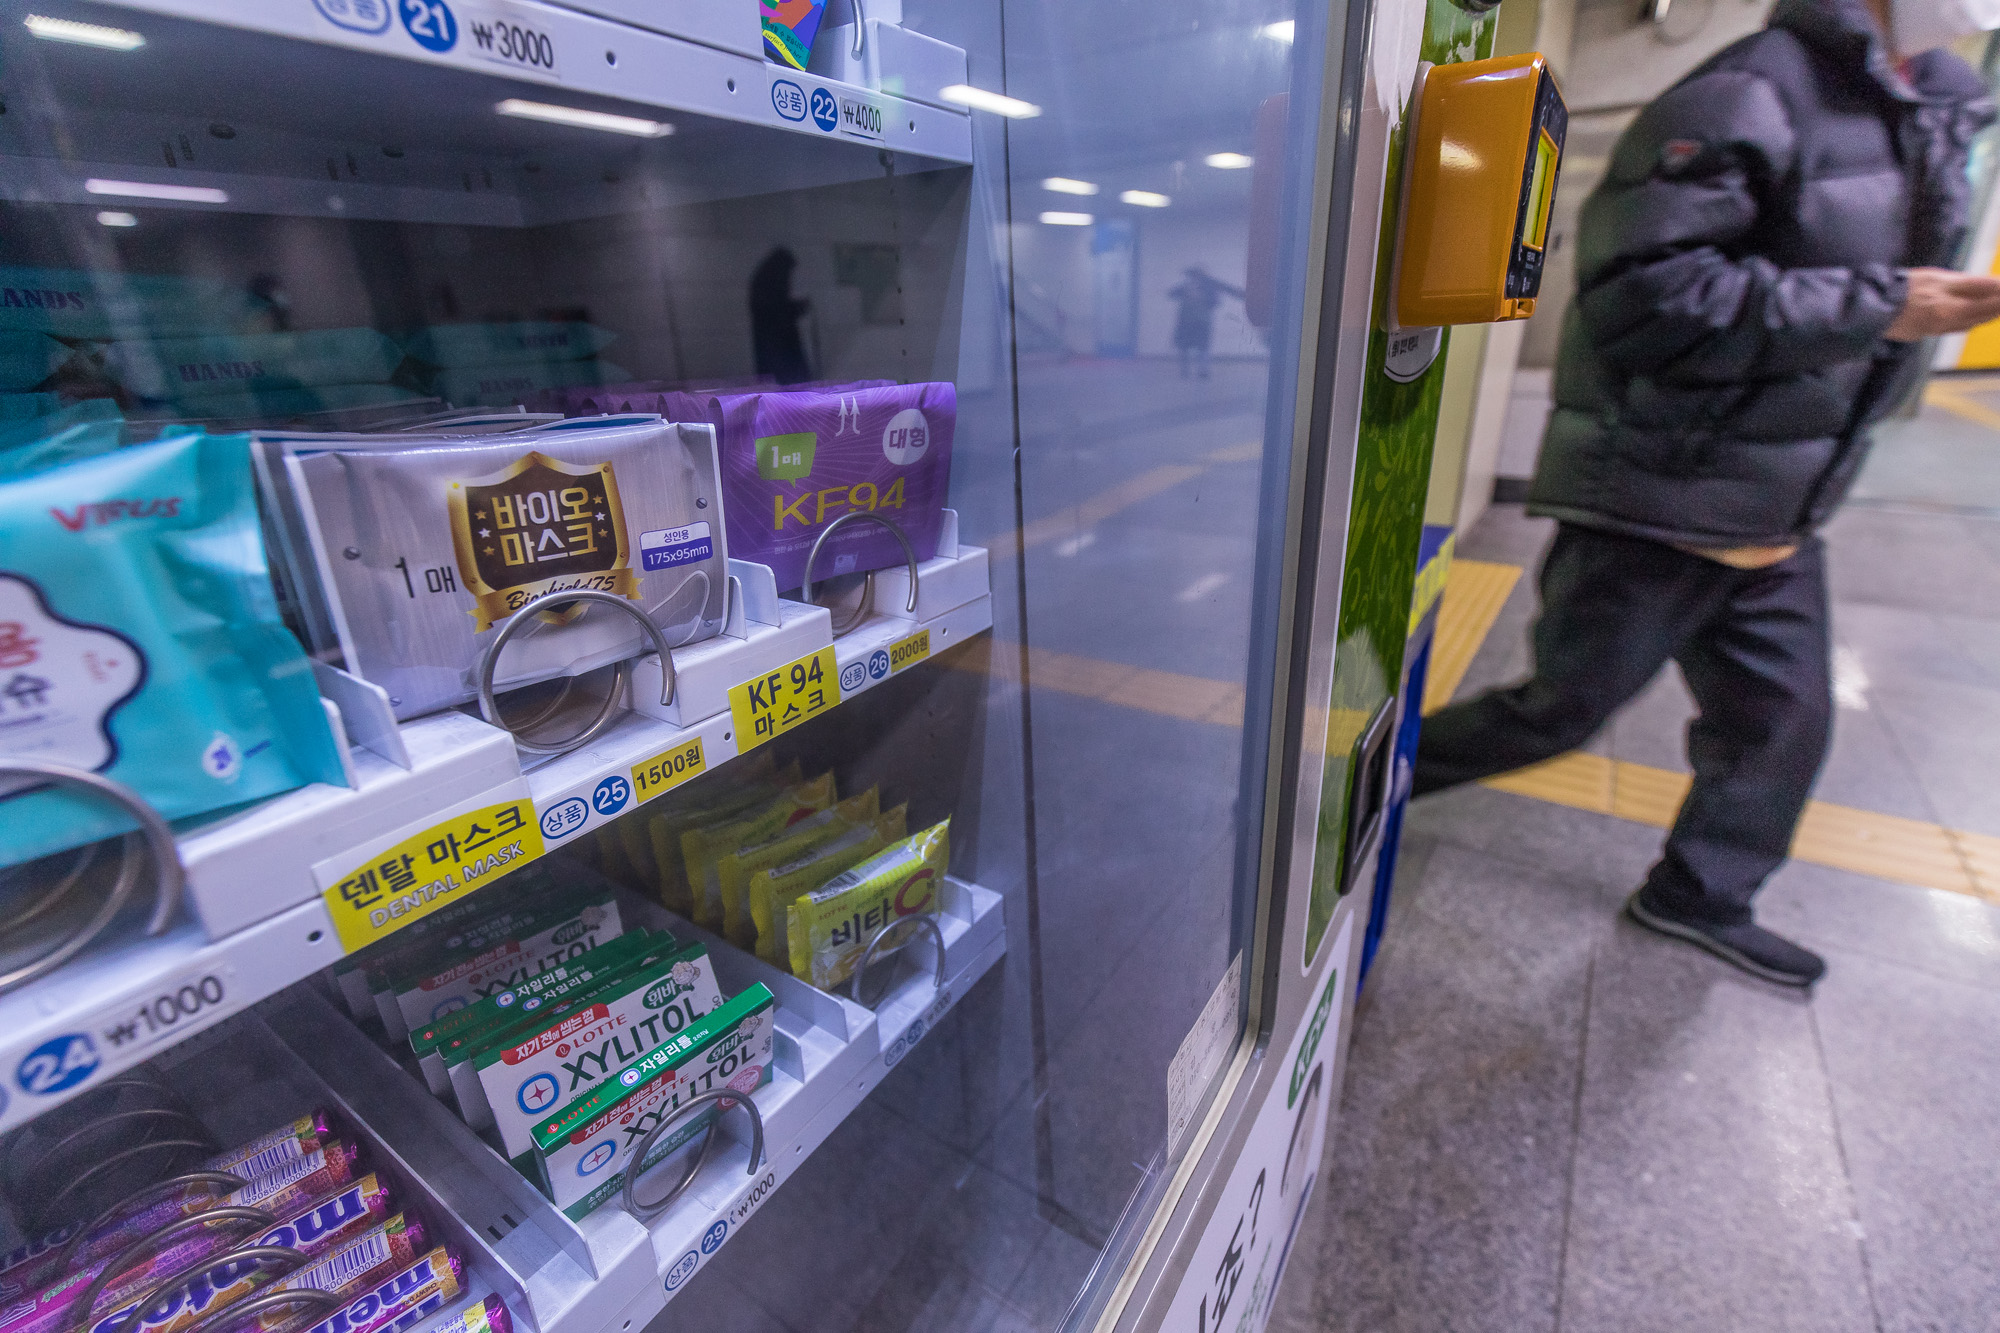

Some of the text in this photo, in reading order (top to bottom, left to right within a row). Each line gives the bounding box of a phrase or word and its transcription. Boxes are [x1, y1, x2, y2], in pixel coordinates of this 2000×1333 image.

[408, 0, 450, 42] 21
[471, 19, 554, 69] ₩3000
[775, 88, 882, 133] 상품 22 ₩4000
[889, 427, 926, 450] 대형
[491, 487, 593, 531] 바이오
[774, 476, 908, 531] KF94
[500, 522, 599, 567] 마스크
[648, 543, 710, 566] 175x95mm
[662, 529, 690, 543] 성인용
[843, 635, 929, 688] 상품 26 2000원
[748, 655, 825, 716] KF 94
[754, 689, 827, 737] 마스크
[545, 745, 702, 833] 상품 25 1500원
[338, 805, 527, 911] 덴탈 마스크
[369, 839, 525, 930] DENTAL MASK
[516, 966, 568, 997] 자일리톨
[542, 970, 594, 1000] 자일리톨
[647, 980, 678, 1007] 휘바
[21, 975, 225, 1092] 24 ₩1000
[560, 996, 705, 1093] XYLITOL
[573, 1013, 628, 1049] LOTTE
[639, 1033, 693, 1073] 자일리톨
[710, 1033, 740, 1061] 휘바
[560, 1094, 602, 1125] LOTTE
[637, 1073, 690, 1113] LOTTE
[284, 1164, 319, 1186] 000053
[703, 1225, 725, 1253] 29
[737, 1172, 775, 1218] ₩1000
[346, 1255, 384, 1280] 000053
